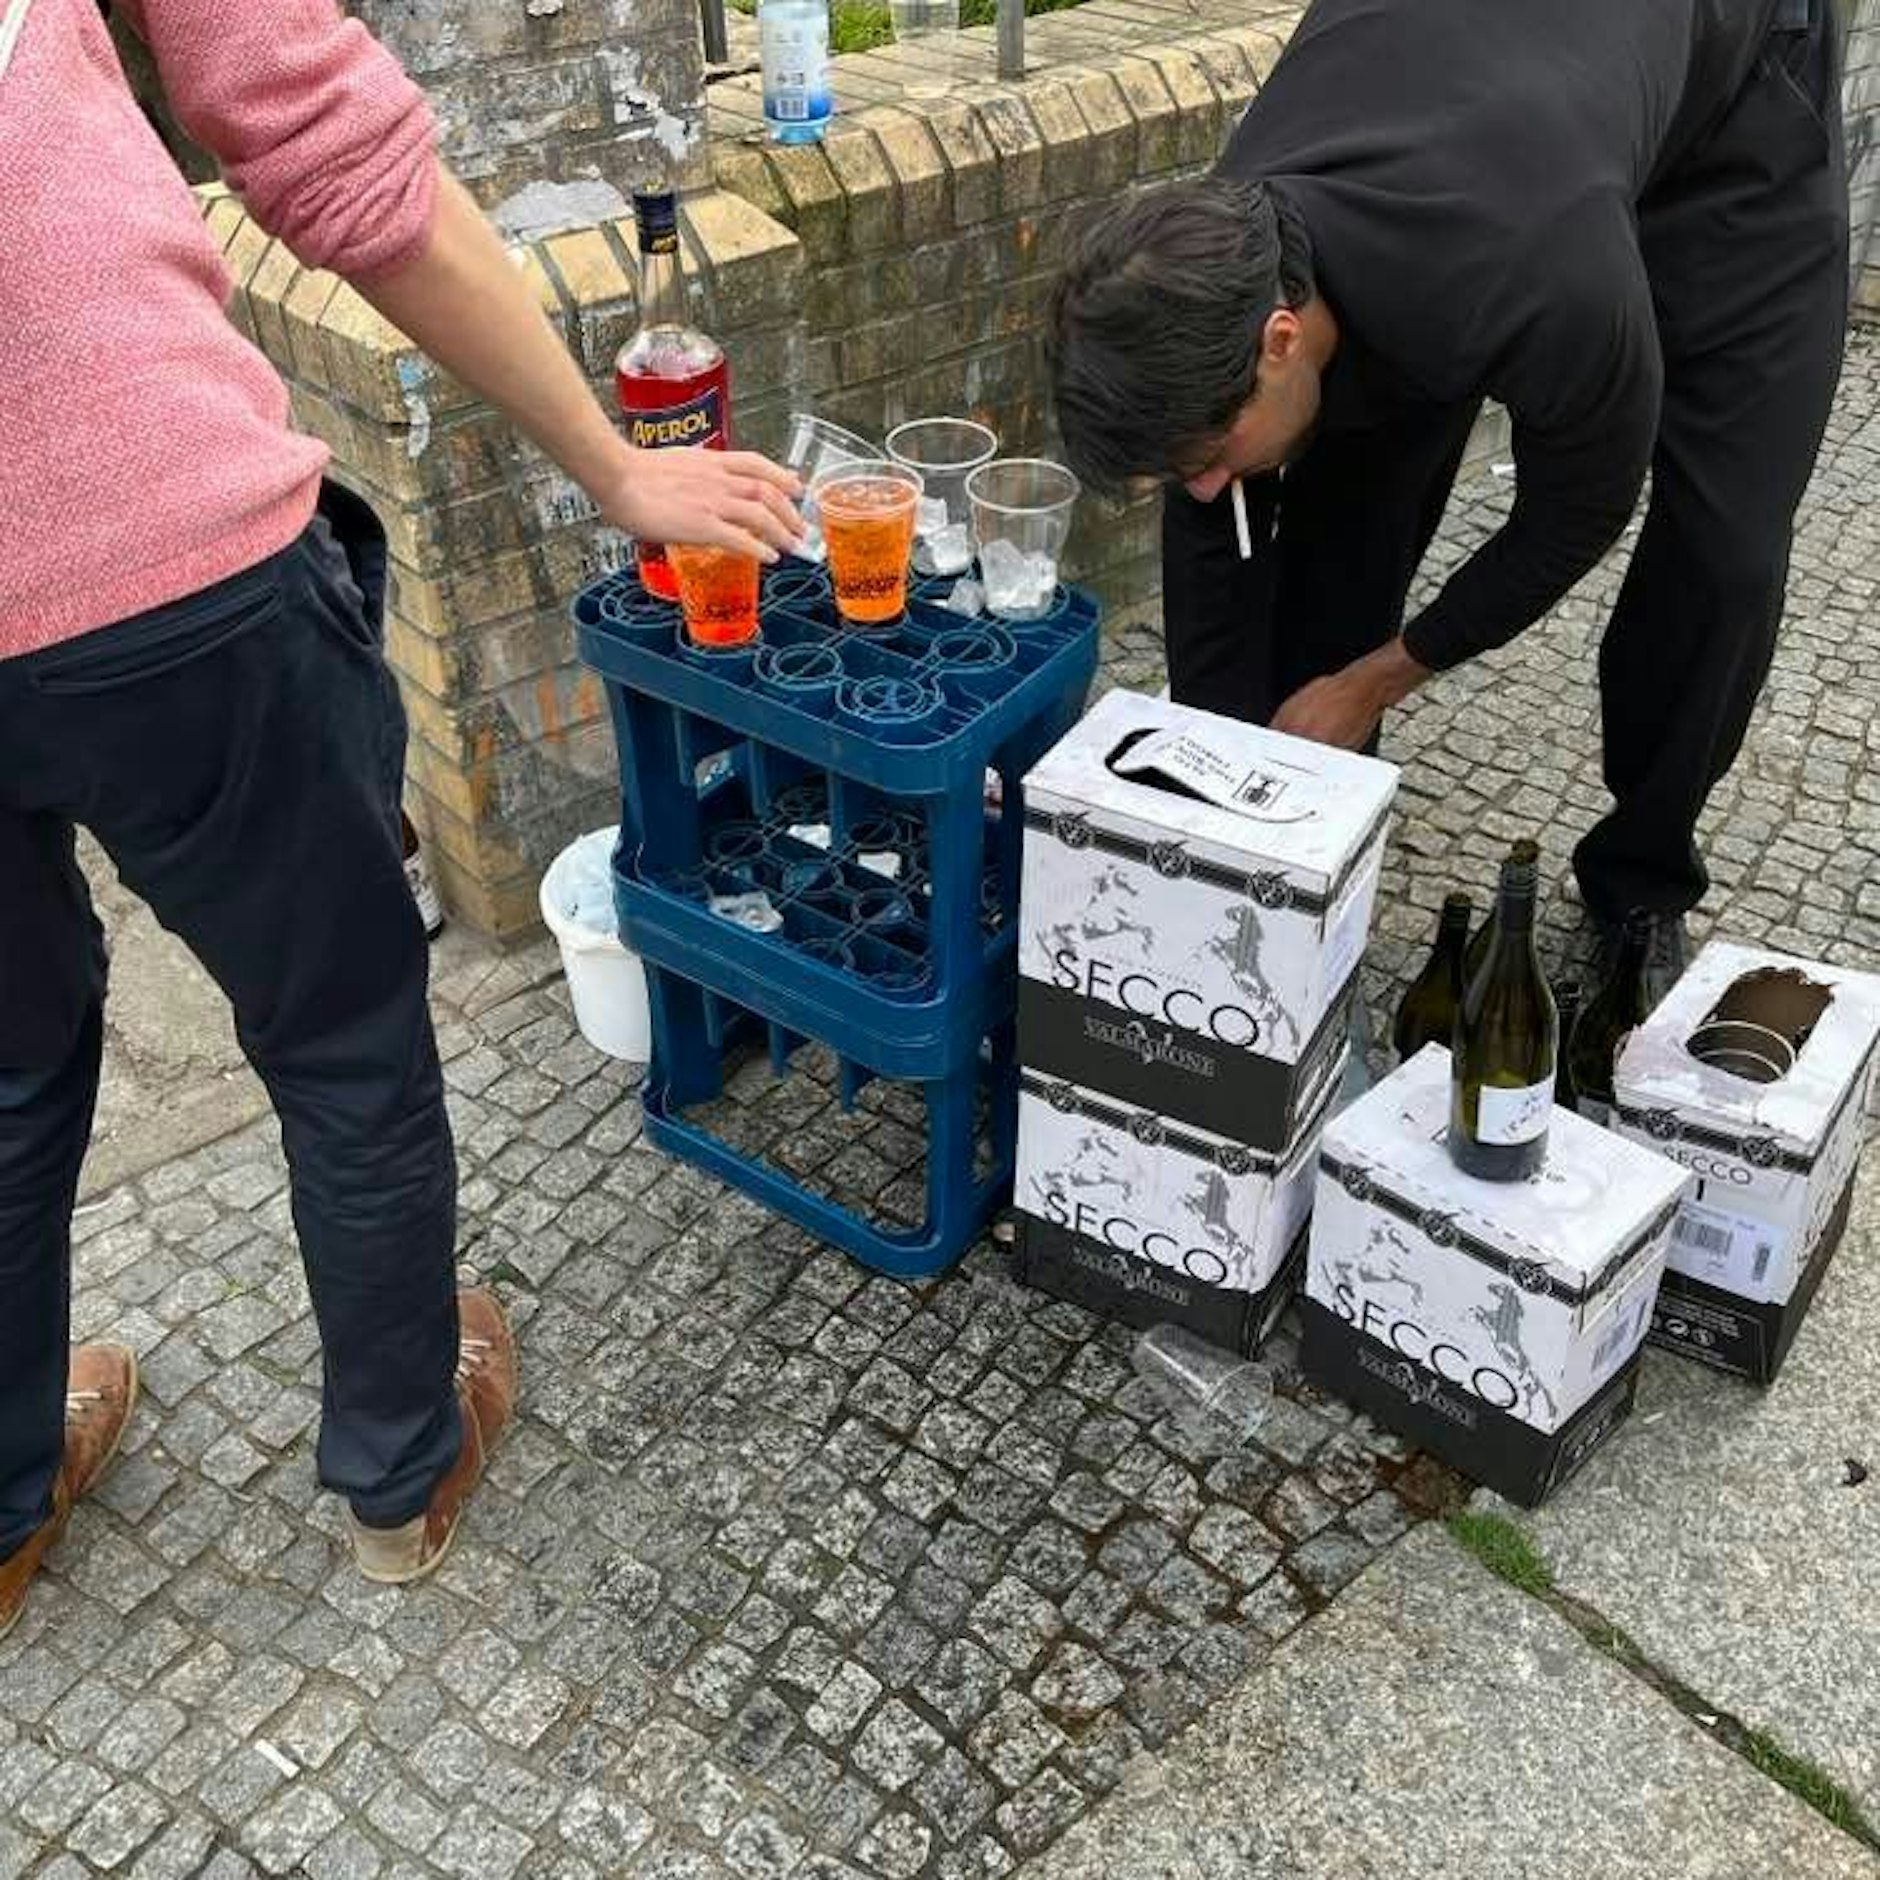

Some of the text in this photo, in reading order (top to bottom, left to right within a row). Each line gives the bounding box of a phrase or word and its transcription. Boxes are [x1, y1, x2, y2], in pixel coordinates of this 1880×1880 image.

[632, 409, 712, 446] APEROL
[1052, 948, 1260, 1047] SECCO
[1331, 1282, 1518, 1410] SECCO
